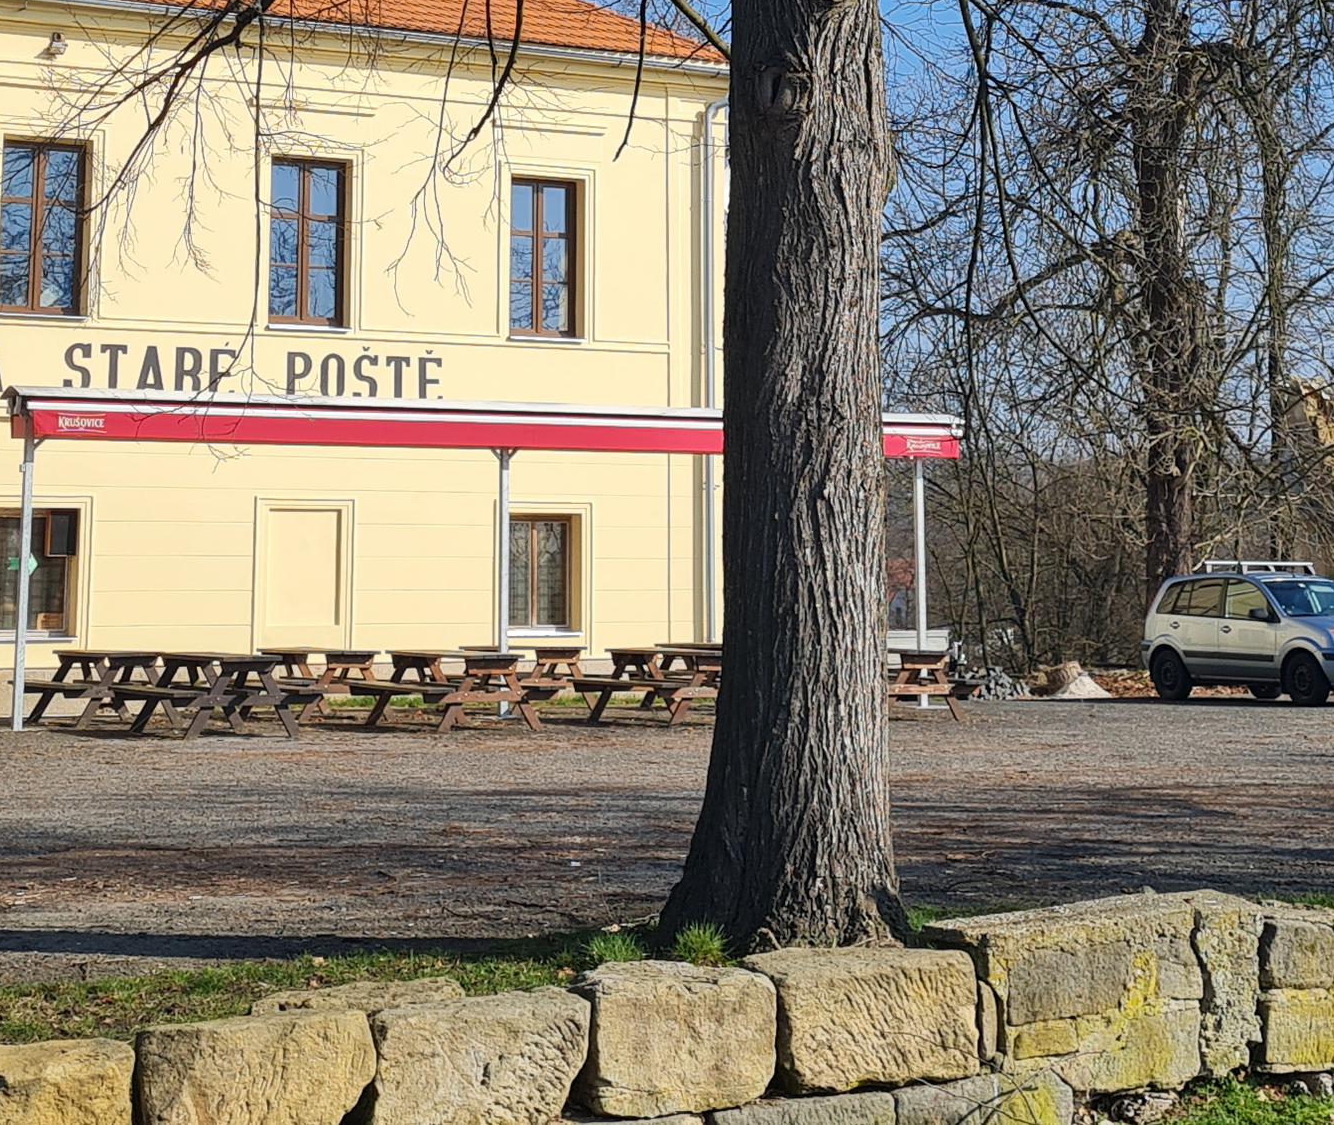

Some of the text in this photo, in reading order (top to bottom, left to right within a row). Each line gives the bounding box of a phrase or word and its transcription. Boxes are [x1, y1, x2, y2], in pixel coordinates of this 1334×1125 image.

[63, 342, 236, 394] STARÉ
[286, 346, 443, 400] POŠTĚ
[58, 415, 105, 429] KRUŠOVICE
